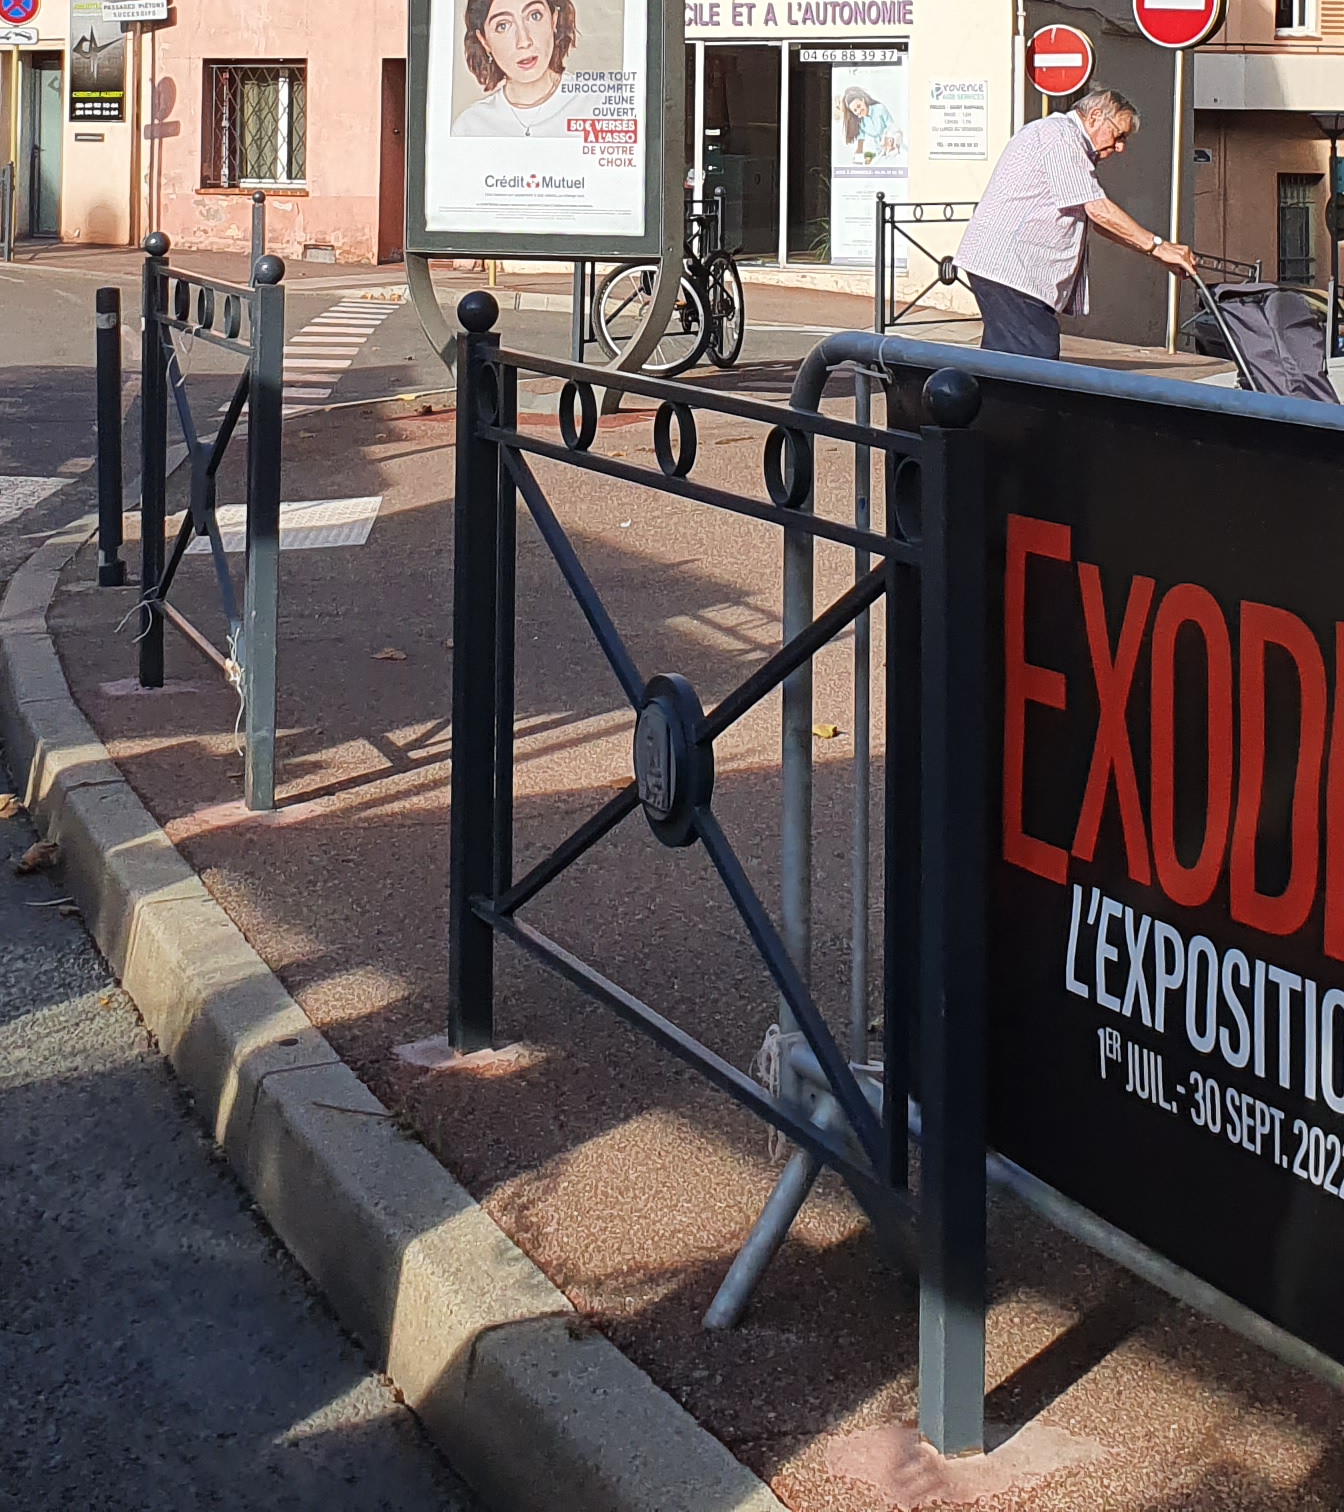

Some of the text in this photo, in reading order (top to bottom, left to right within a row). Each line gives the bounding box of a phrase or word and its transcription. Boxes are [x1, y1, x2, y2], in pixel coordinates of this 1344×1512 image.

[685, 0, 914, 26] CILE ET A L'AUTONOMIE
[802, 50, 895, 61] 04 66 88 39 37
[576, 71, 637, 81] POUR TOUT
[561, 84, 635, 93] EUROCOMPTE
[601, 95, 635, 105] JEUNE
[592, 107, 637, 118] OUVERT,
[570, 120, 584, 131] 50
[584, 120, 593, 131] €
[598, 132, 635, 143] L'ASSO
[582, 145, 635, 156] DE VOTRE
[598, 157, 637, 168] CHOIX.
[484, 174, 585, 189] Crédit Mutuel
[1190, 1069, 1222, 1136] 30
[1225, 1087, 1289, 1169] SEPT.
